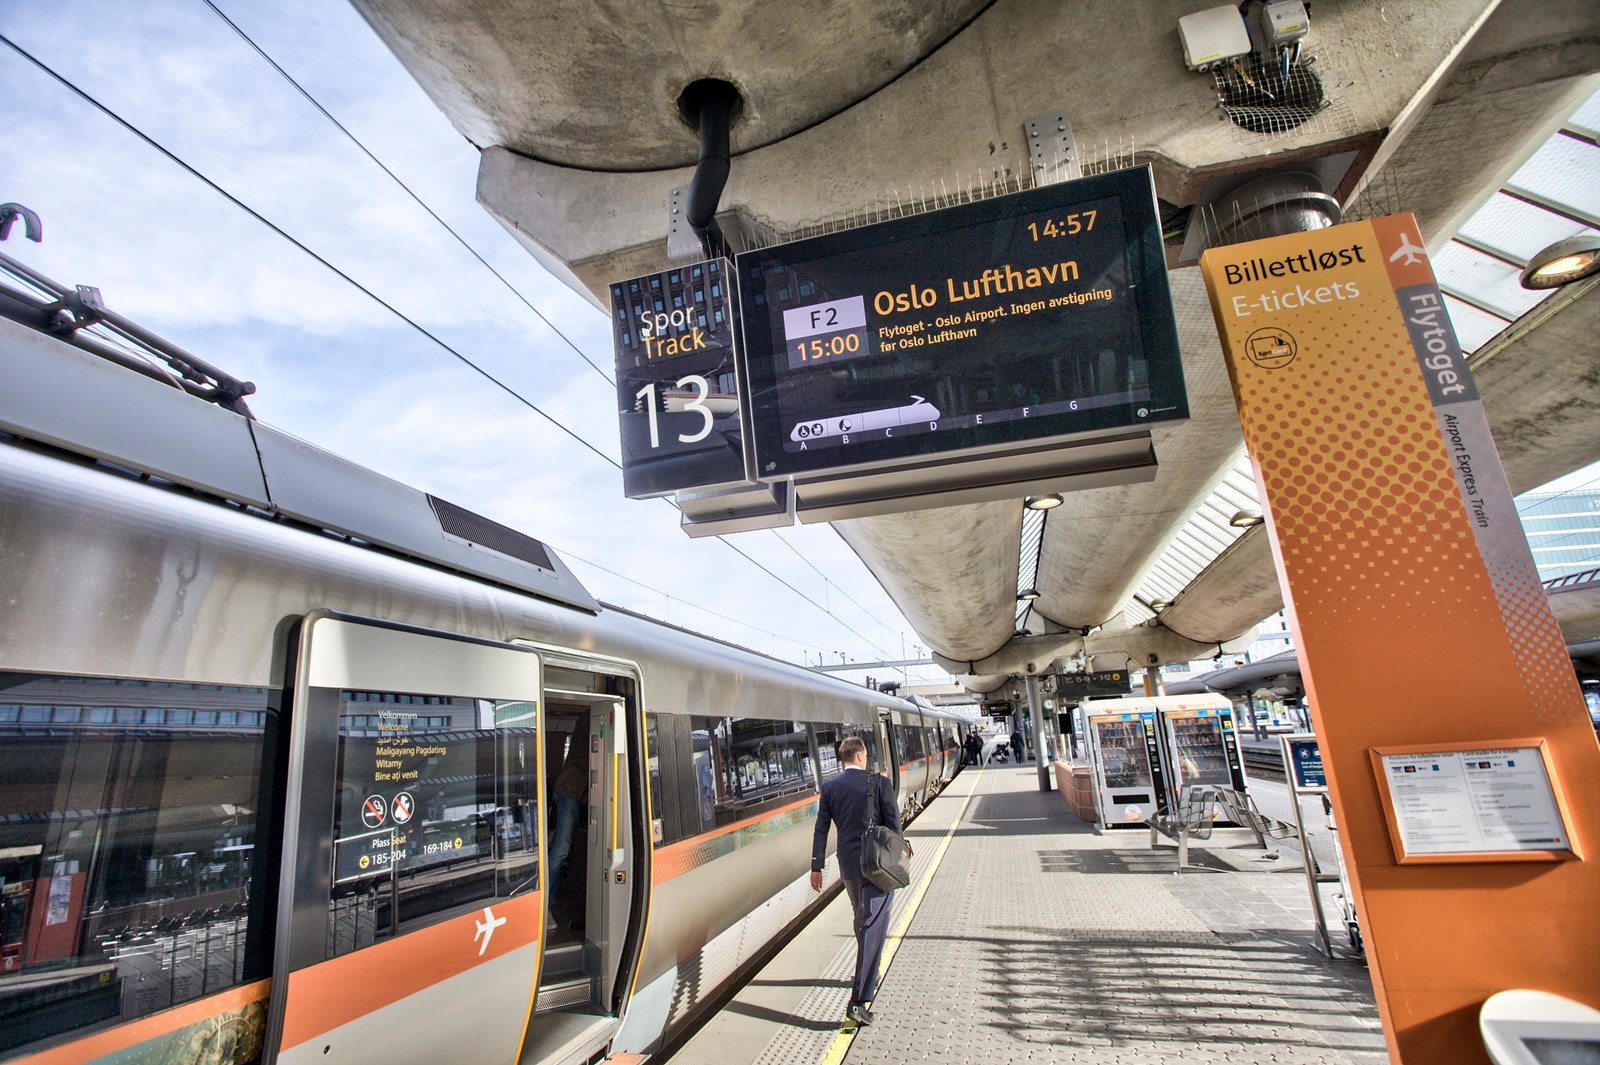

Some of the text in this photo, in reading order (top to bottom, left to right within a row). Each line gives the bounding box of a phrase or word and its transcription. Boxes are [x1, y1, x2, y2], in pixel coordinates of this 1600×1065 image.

[1028, 209, 1098, 242] 14:57
[1223, 243, 1366, 286] Billettløst
[873, 259, 1079, 316] Oslo Lufthavn
[1231, 281, 1361, 318] E-tickets
[641, 307, 695, 335] Spor
[810, 307, 838, 329] F2
[879, 320, 925, 338] Flytoget
[935, 314, 961, 329] Oslo
[964, 306, 1008, 325] Airport.
[1010, 300, 1046, 317] Ingen
[1048, 287, 1112, 308] avstigning
[642, 327, 707, 359] Track
[798, 334, 860, 361] 15:00
[880, 326, 977, 353] før Oslo Lufthavn
[1410, 292, 1465, 396] Flytoget
[636, 374, 714, 448] 13
[800, 400, 1078, 450] A B C D E F G
[1444, 413, 1489, 528] Airport Express Train
[377, 722, 409, 731] Welcome
[378, 710, 417, 719] Velkommen
[376, 745, 446, 757] Maligayang Pagdating
[376, 759, 403, 769] Witamy
[375, 771, 391, 781] Bine
[402, 770, 418, 779] venit
[372, 835, 406, 849] Plass Seat
[423, 840, 453, 854] 169-184
[372, 849, 406, 865] 185-204
